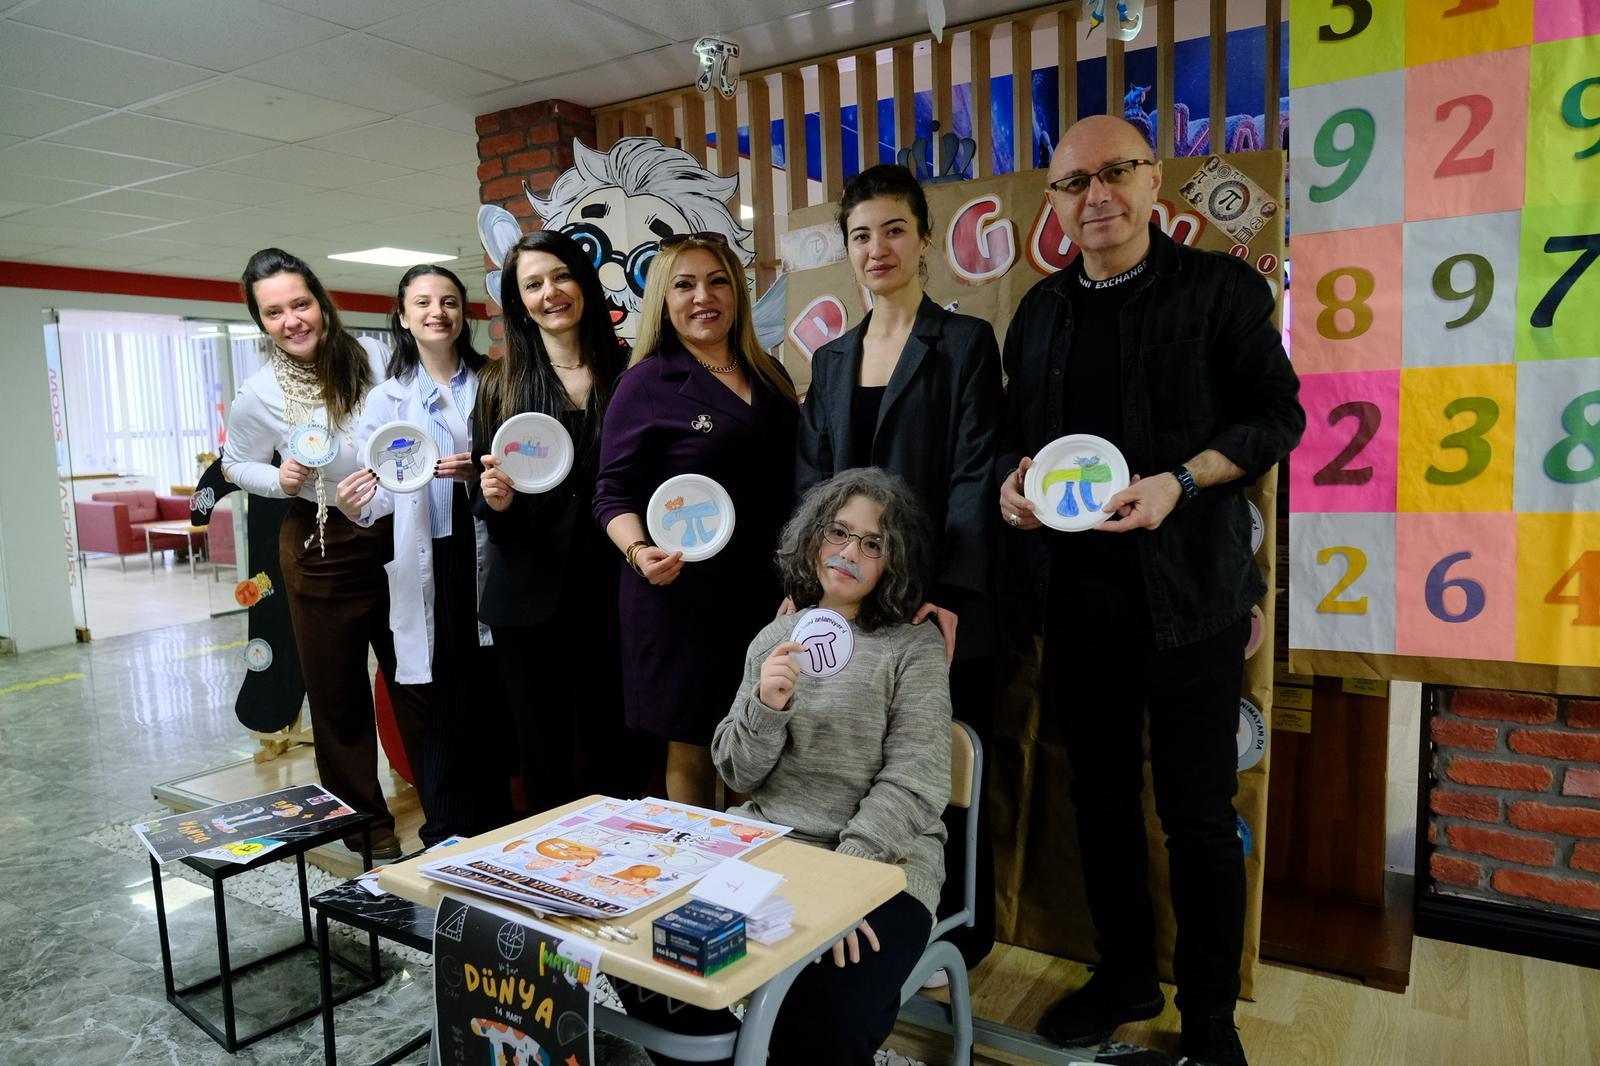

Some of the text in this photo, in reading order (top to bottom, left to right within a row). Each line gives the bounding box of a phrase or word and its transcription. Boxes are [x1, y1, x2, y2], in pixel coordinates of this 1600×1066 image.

[1308, 107, 1376, 203] 9
[1433, 94, 1495, 178] 2
[1316, 233, 1600, 340] 8 9 7
[1313, 389, 1600, 486] 2 3 8
[1316, 545, 1600, 626] 2 6 4
[1240, 701, 1265, 750] NIMAYAN DA
[464, 963, 554, 1029] DÜNYA
[544, 951, 579, 978] MATH
[494, 1006, 523, 1025] 14 MART
